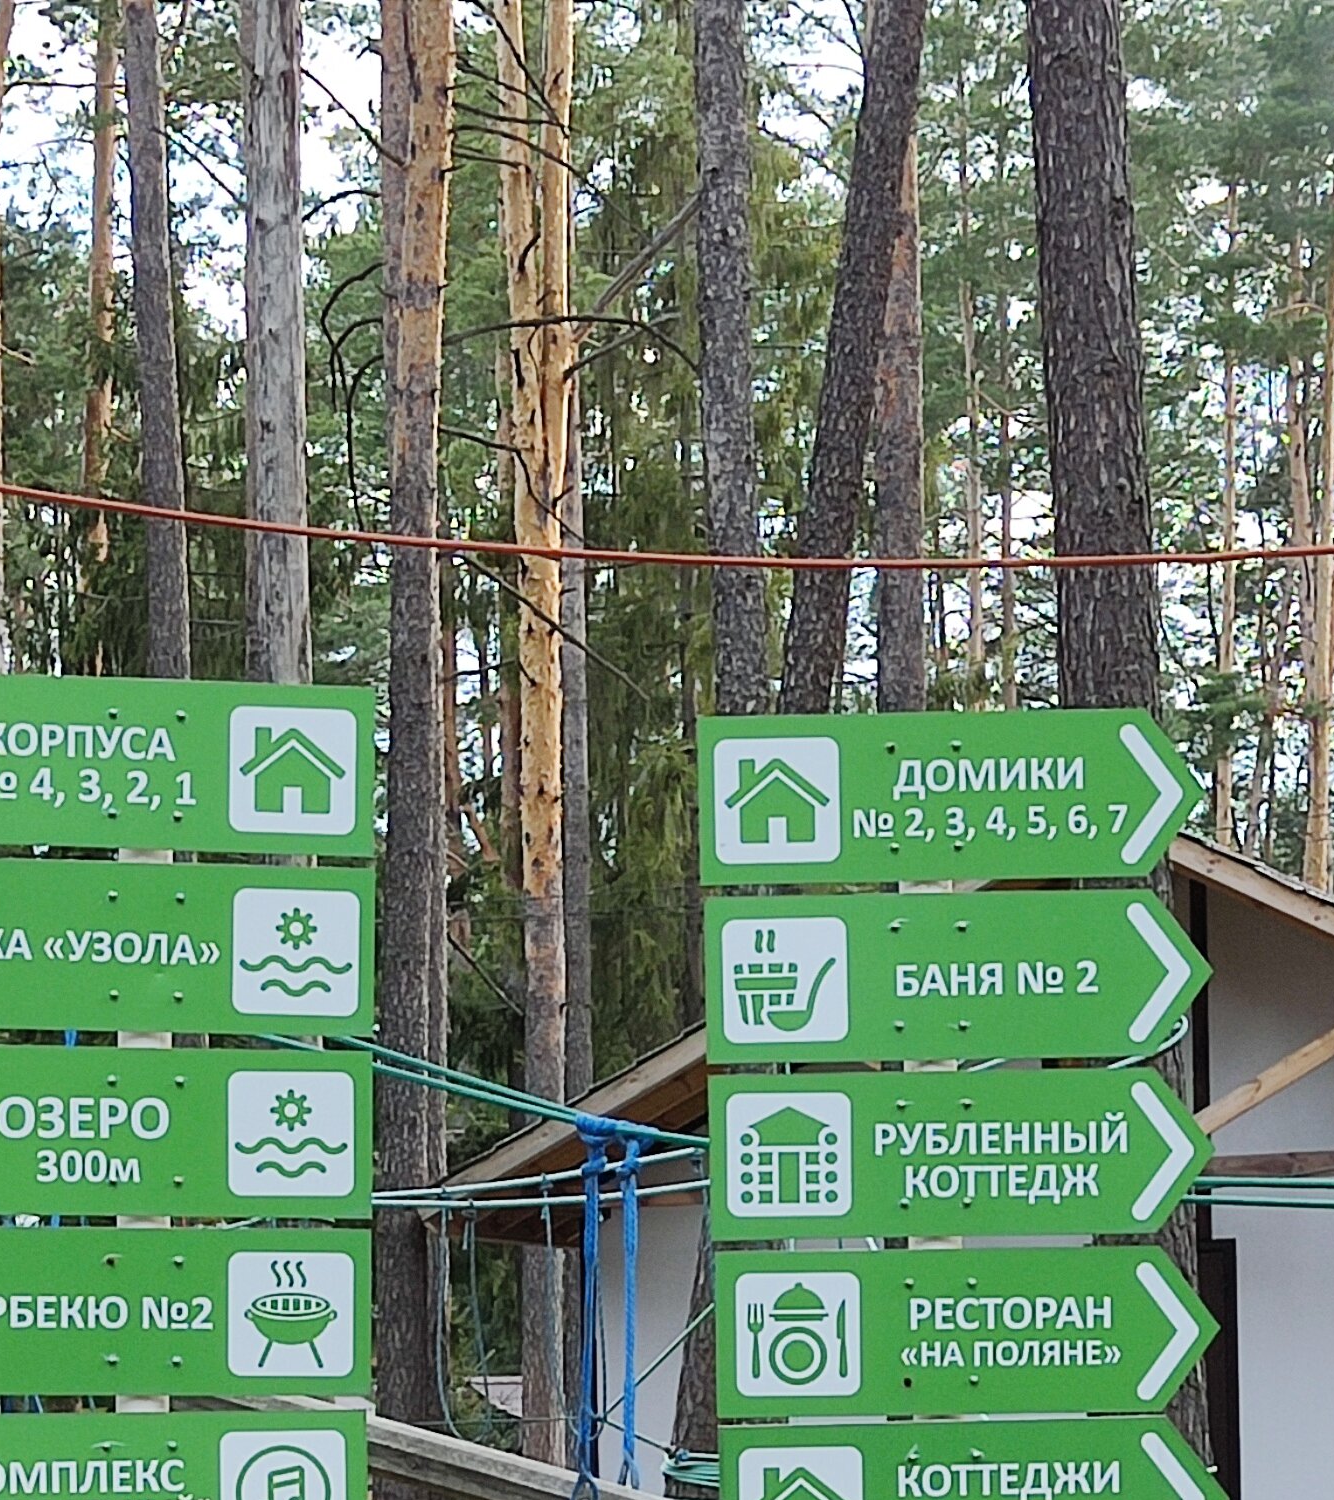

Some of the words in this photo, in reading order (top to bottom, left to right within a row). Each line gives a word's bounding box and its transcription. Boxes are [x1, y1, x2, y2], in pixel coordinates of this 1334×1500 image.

[29, 768, 66, 807] 4,
[78, 770, 115, 809] 3,
[126, 771, 162, 811] 2,
[175, 773, 197, 805] 1
[893, 757, 1085, 800] ДОМИКИ
[853, 809, 895, 839] №
[904, 808, 936, 842] 2,
[946, 807, 976, 841] 3,
[985, 807, 1016, 841] 4,
[1027, 806, 1058, 840] 5,
[1067, 805, 1099, 838] 6,
[1107, 805, 1128, 833] 7
[43, 930, 221, 966] «УЗОЛА»
[896, 963, 1003, 998] БАНЯ
[1017, 962, 1064, 994] №
[1076, 961, 1099, 994] 2
[874, 1112, 1128, 1156] РУБЛЕННЫЙ
[36, 1150, 141, 1183] 300м
[905, 1164, 1100, 1203] КОТТЕДЖ
[142, 1297, 214, 1330] №2
[910, 1296, 1113, 1331] РЕСТОРАН
[901, 1340, 964, 1367] «НА
[973, 1339, 1121, 1366] ПОЛЯНЕ»
